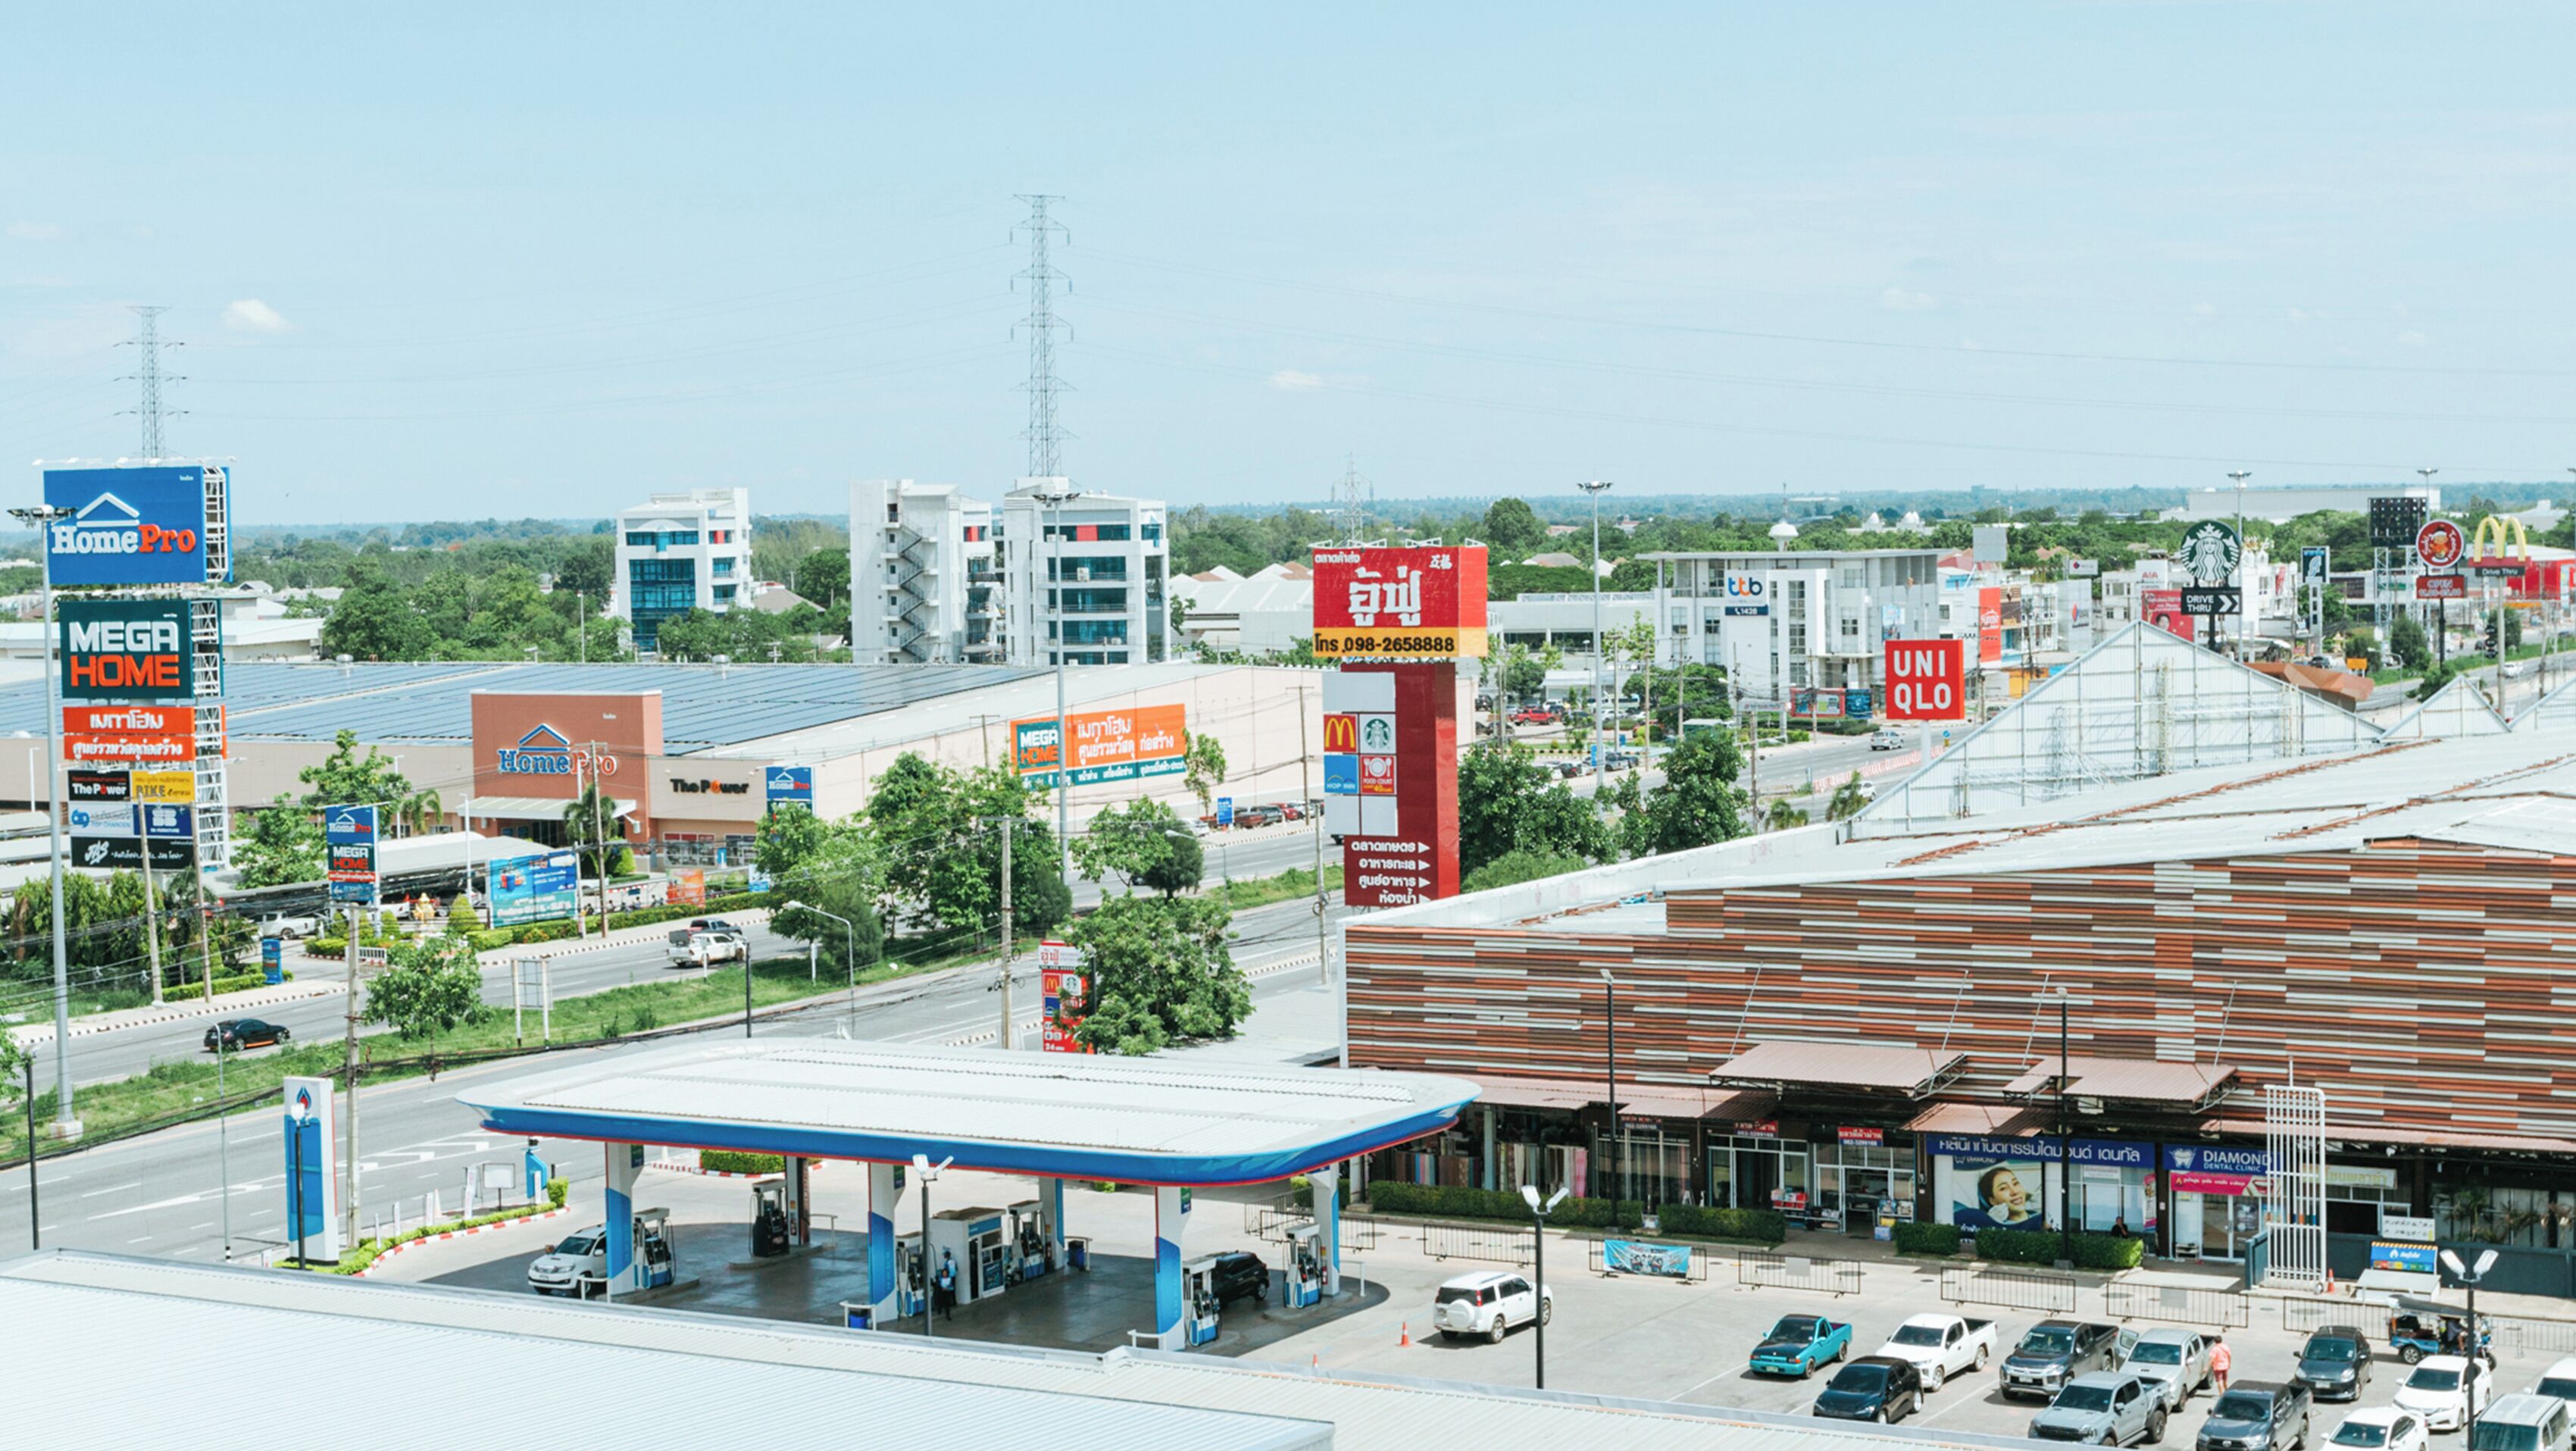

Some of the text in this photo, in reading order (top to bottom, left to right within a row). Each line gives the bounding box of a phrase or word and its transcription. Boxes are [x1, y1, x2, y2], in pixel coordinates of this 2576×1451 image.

[51, 524, 197, 554] HomePro
[1348, 566, 1422, 627] อู้ฟู่
[1728, 577, 1763, 597] ttb
[2187, 595, 2215, 604] DRIVE
[2187, 604, 2212, 613] THRU
[69, 621, 179, 652] MEGA
[70, 654, 180, 686] HOME
[1893, 649, 1946, 677] UNI
[1894, 682, 1952, 715] QLO
[89, 709, 164, 729] เมกาโฮม
[1021, 730, 1058, 747] MEGA
[1021, 746, 1058, 765] HOME
[671, 778, 699, 793] The
[768, 780, 810, 790] HomePro
[333, 846, 369, 858] MEGA
[334, 858, 369, 869] HOME
[2203, 1150, 2272, 1165] DIAMOND
